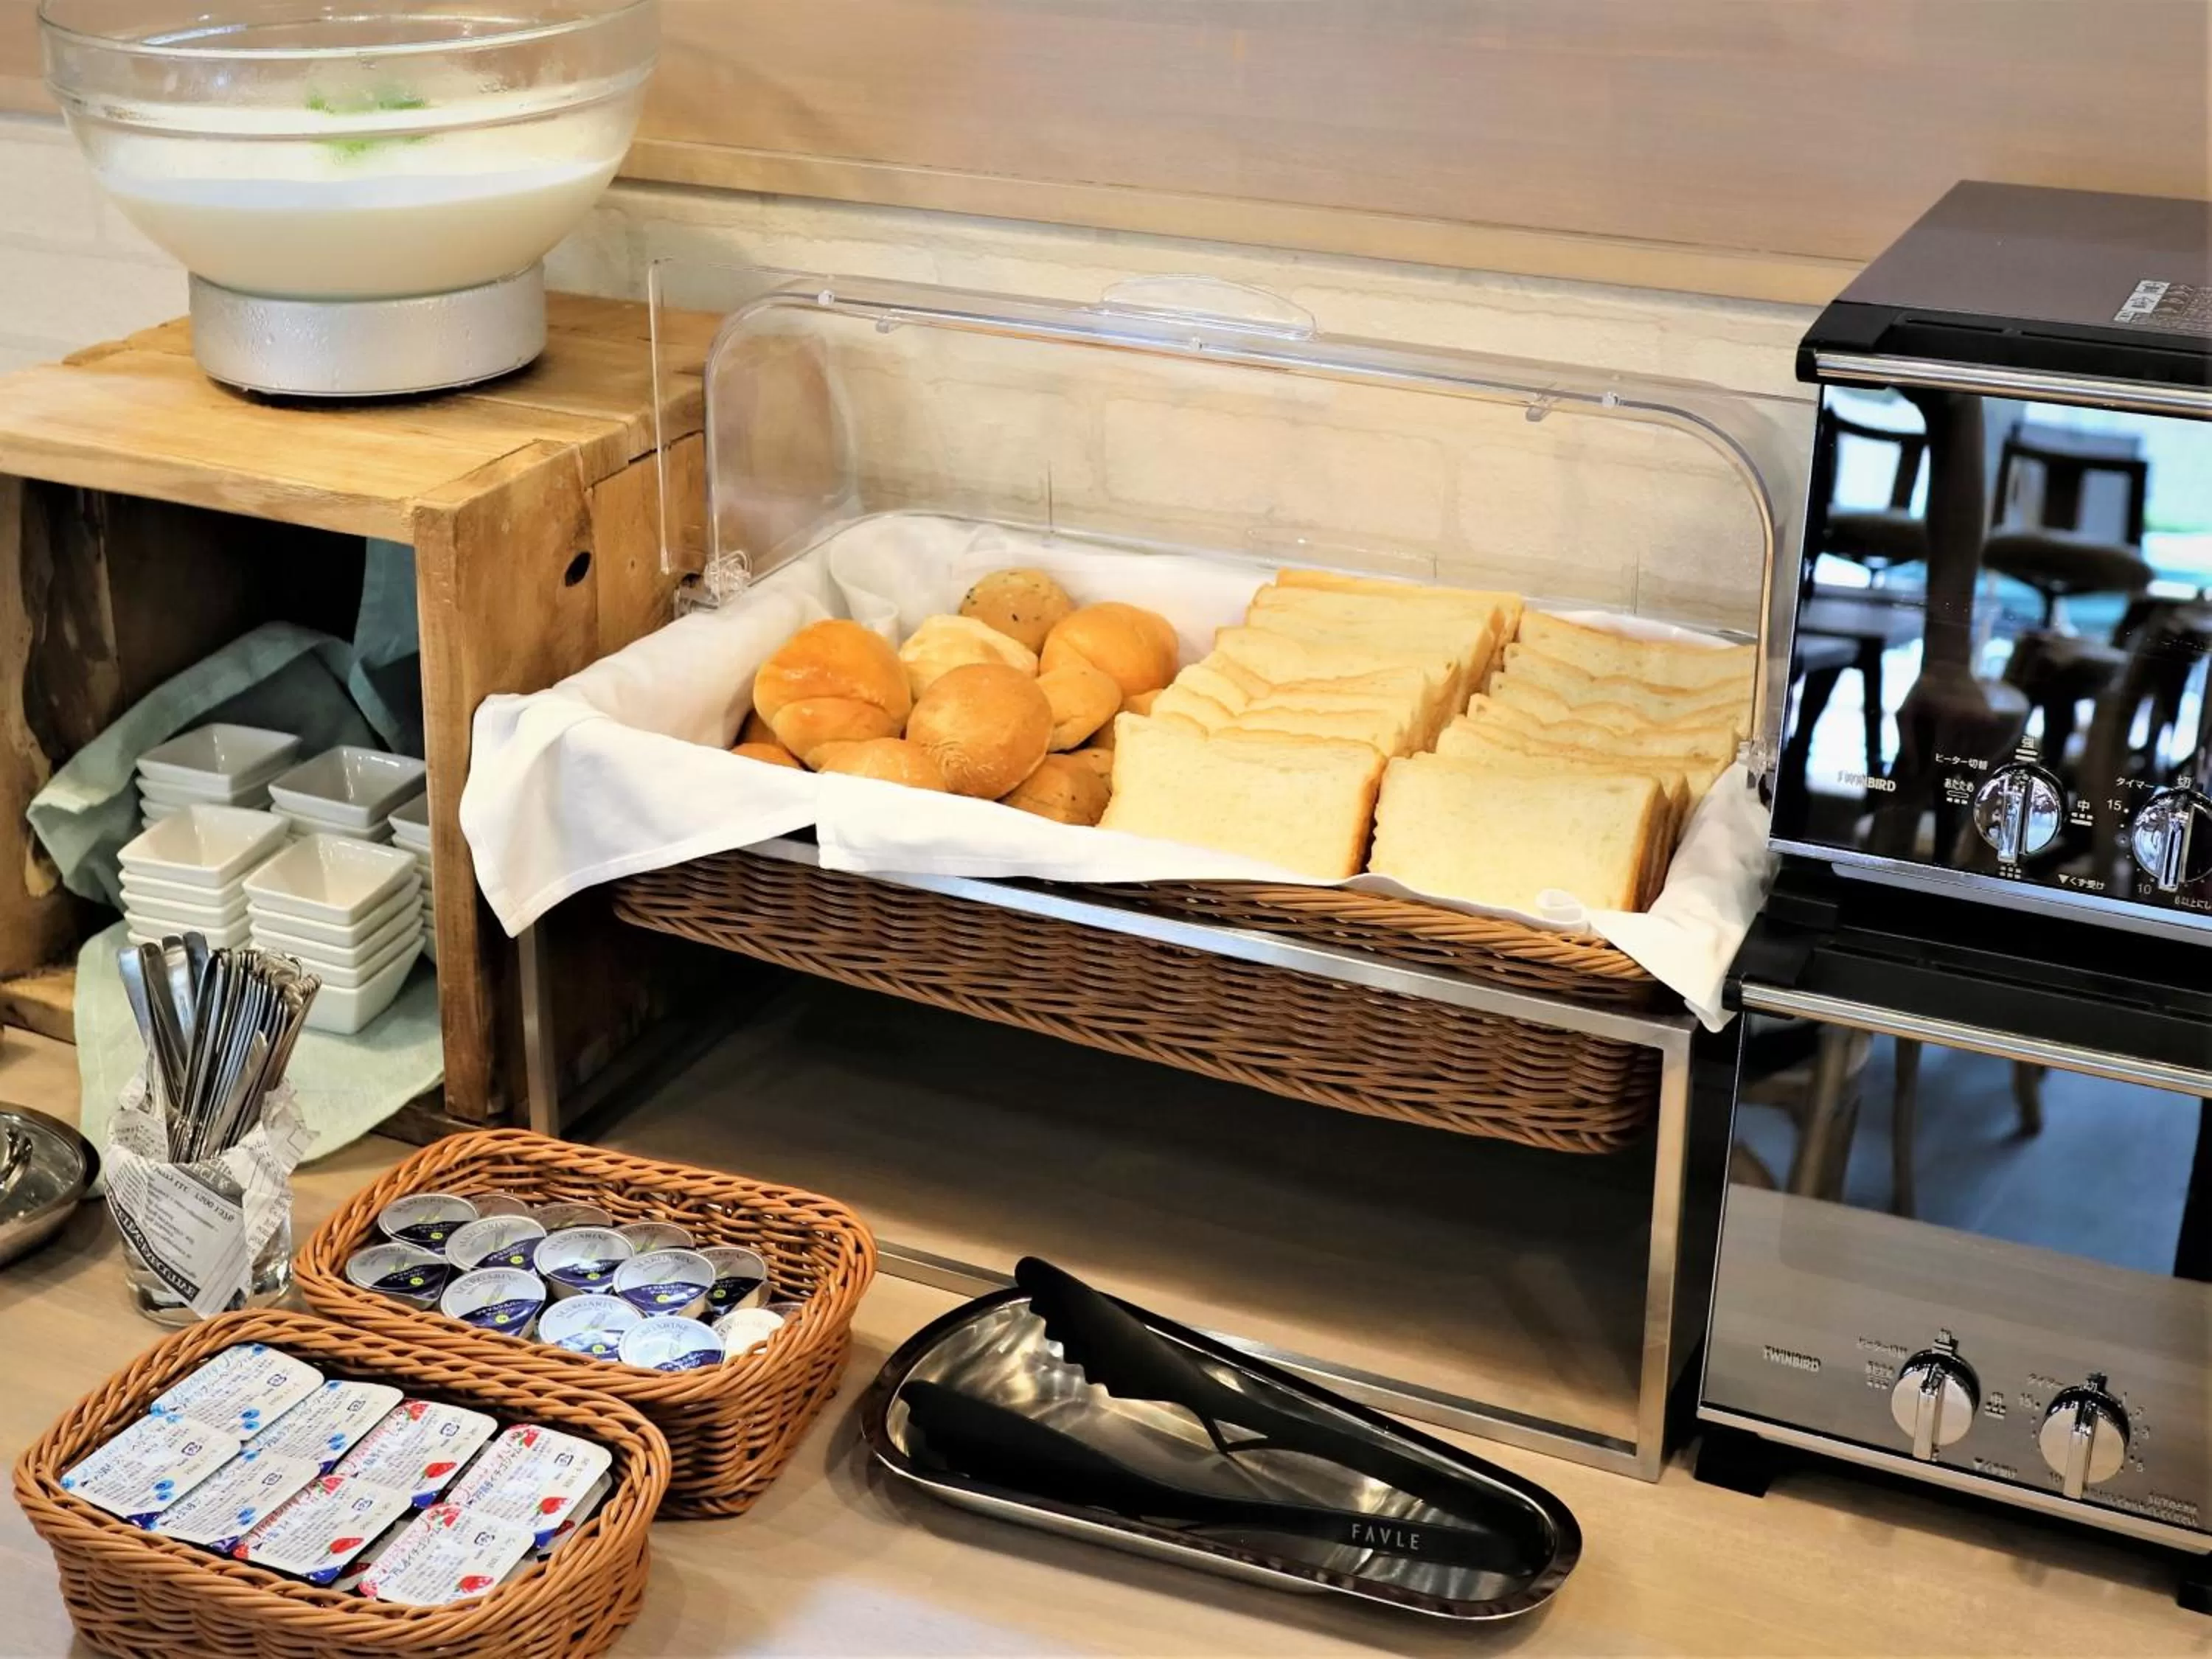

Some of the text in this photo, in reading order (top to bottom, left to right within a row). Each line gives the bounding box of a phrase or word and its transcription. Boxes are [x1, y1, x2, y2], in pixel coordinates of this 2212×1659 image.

[2115, 777, 2155, 789] タイマー
[2077, 799, 2090, 812] 中
[2107, 799, 2122, 811] 15
[2138, 884, 2152, 895] 10
[1763, 1346, 1821, 1372] TWINBIRD
[1352, 1523, 1420, 1550] FAVLE
